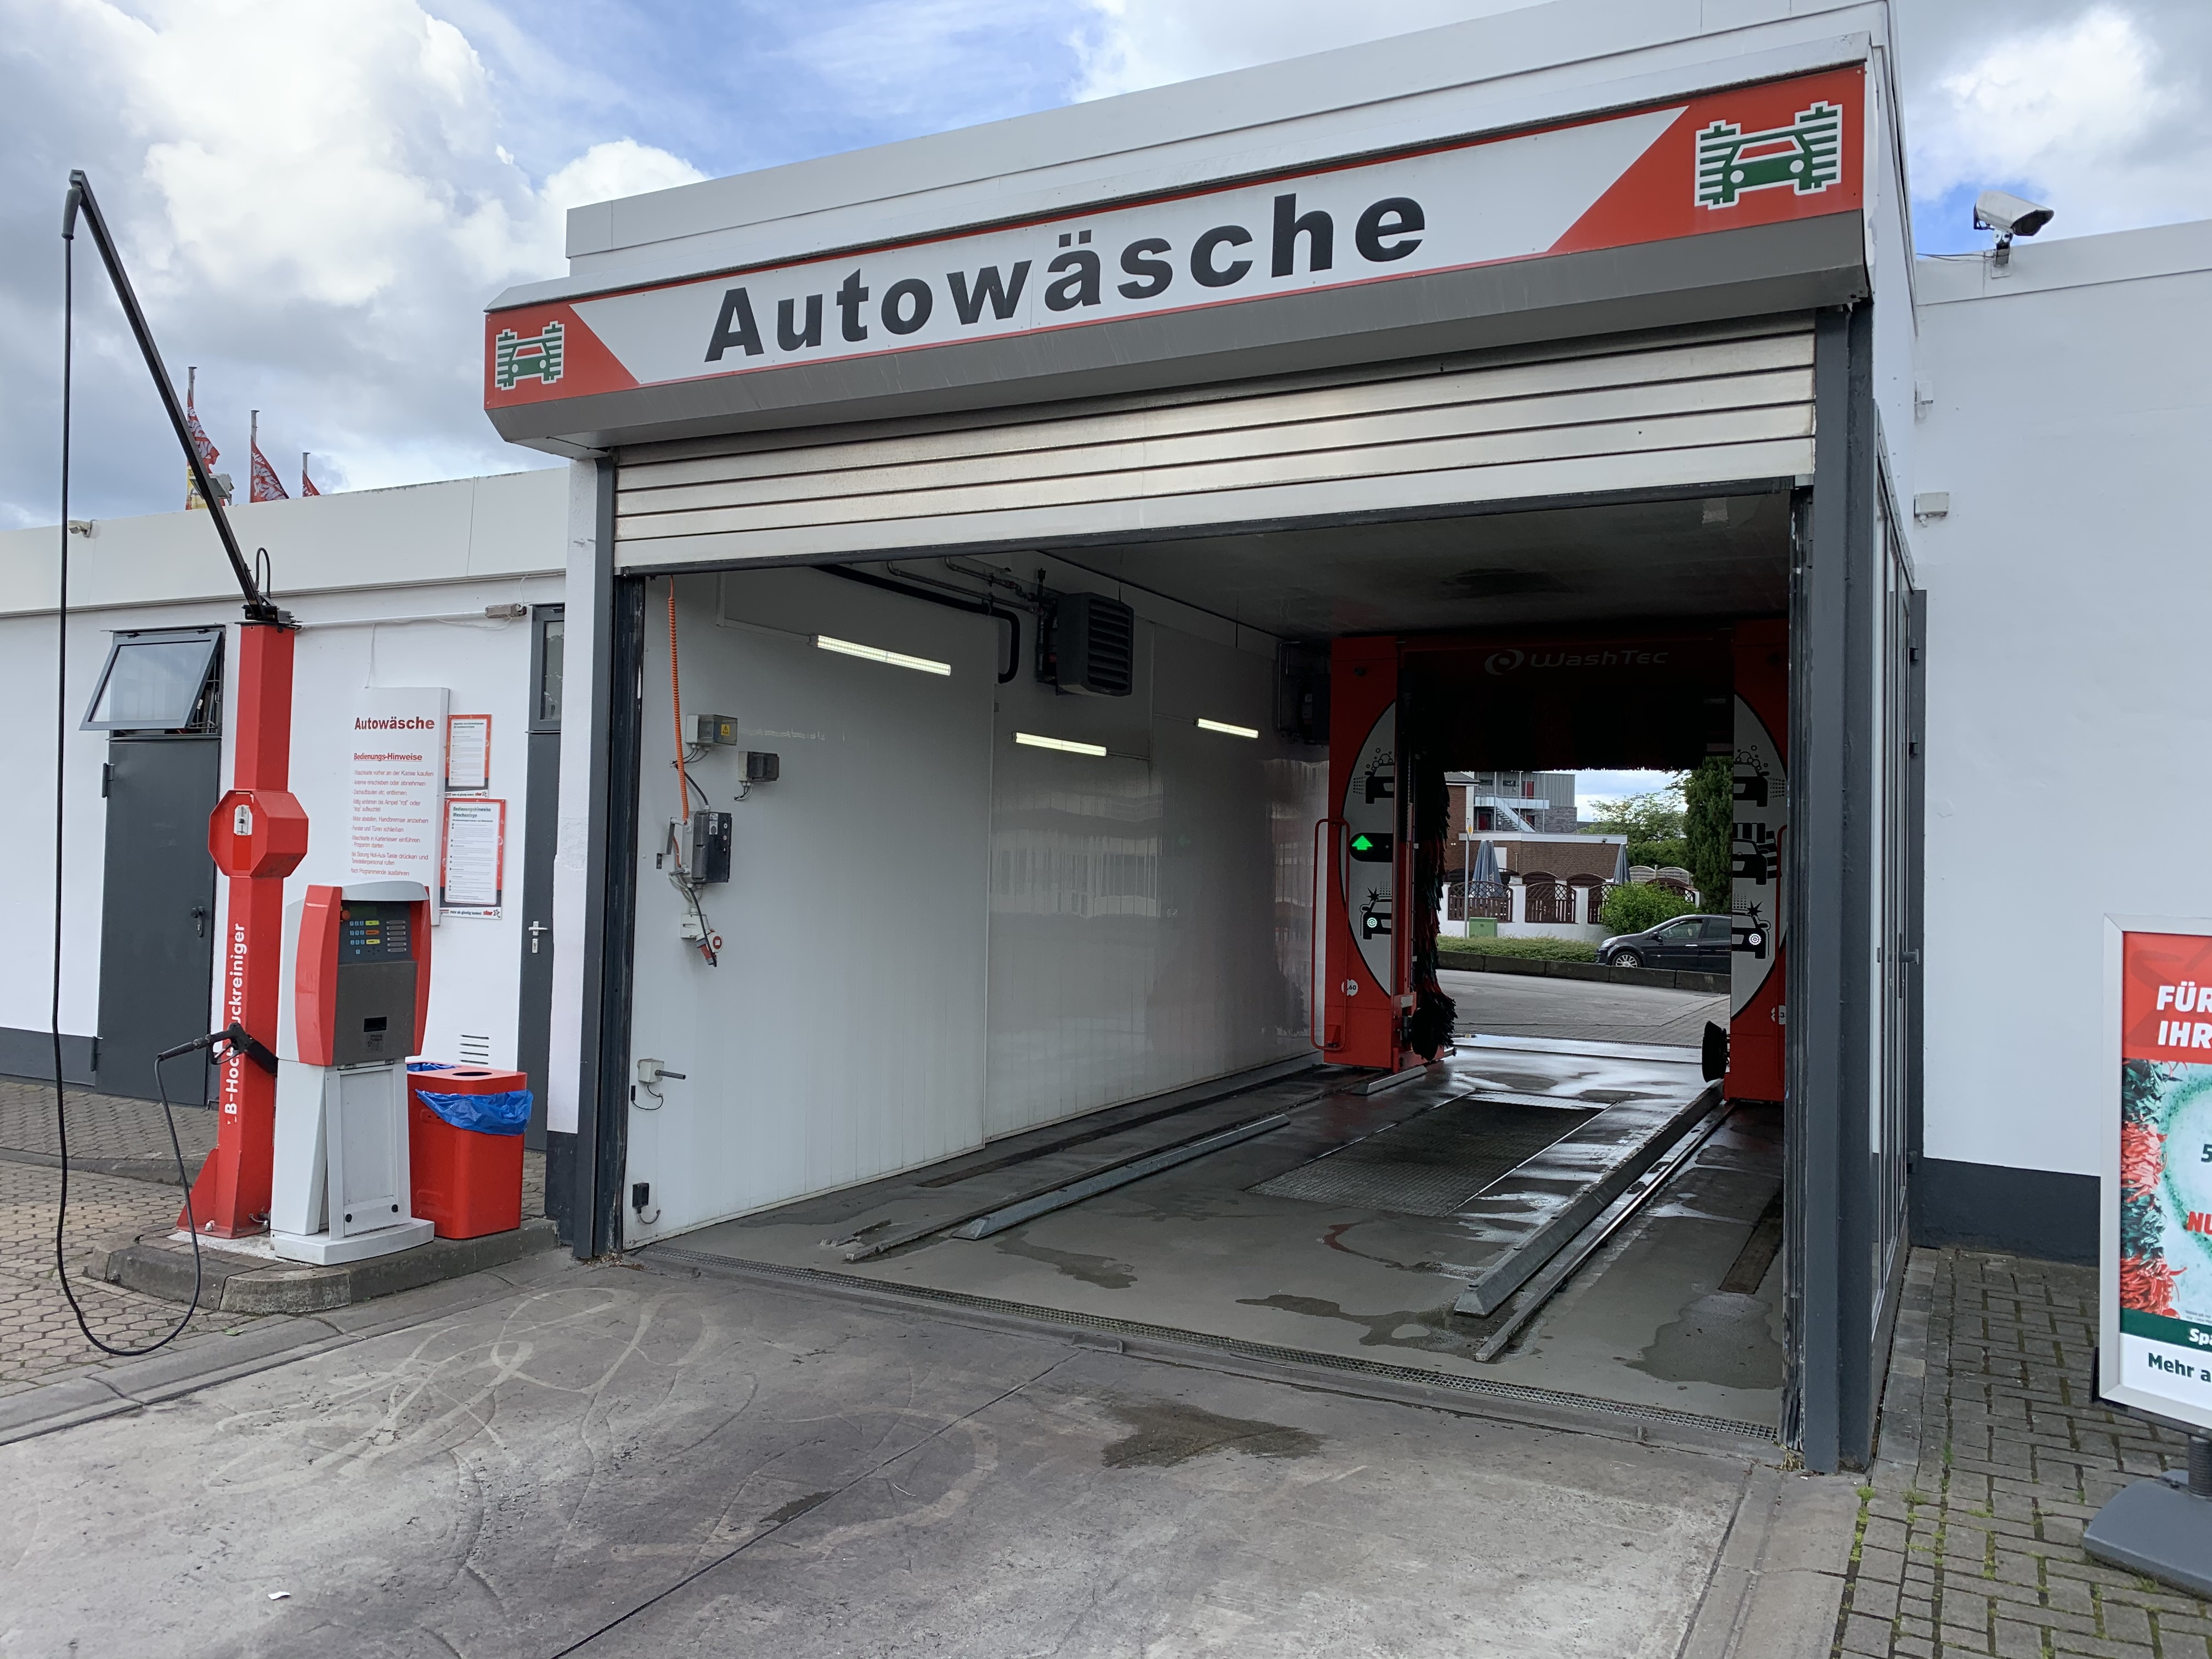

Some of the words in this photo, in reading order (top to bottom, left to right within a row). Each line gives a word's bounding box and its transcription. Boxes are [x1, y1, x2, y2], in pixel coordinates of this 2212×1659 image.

[703, 192, 1426, 363] Autowäsche
[1530, 650, 1668, 668] WashTec
[354, 716, 435, 730] Autowäsche
[353, 753, 422, 761] Bedienungs-Hinweise
[2157, 981, 2212, 1013] FÜR
[2158, 1020, 2212, 1049] IHR
[2148, 1352, 2195, 1378] Mehr
